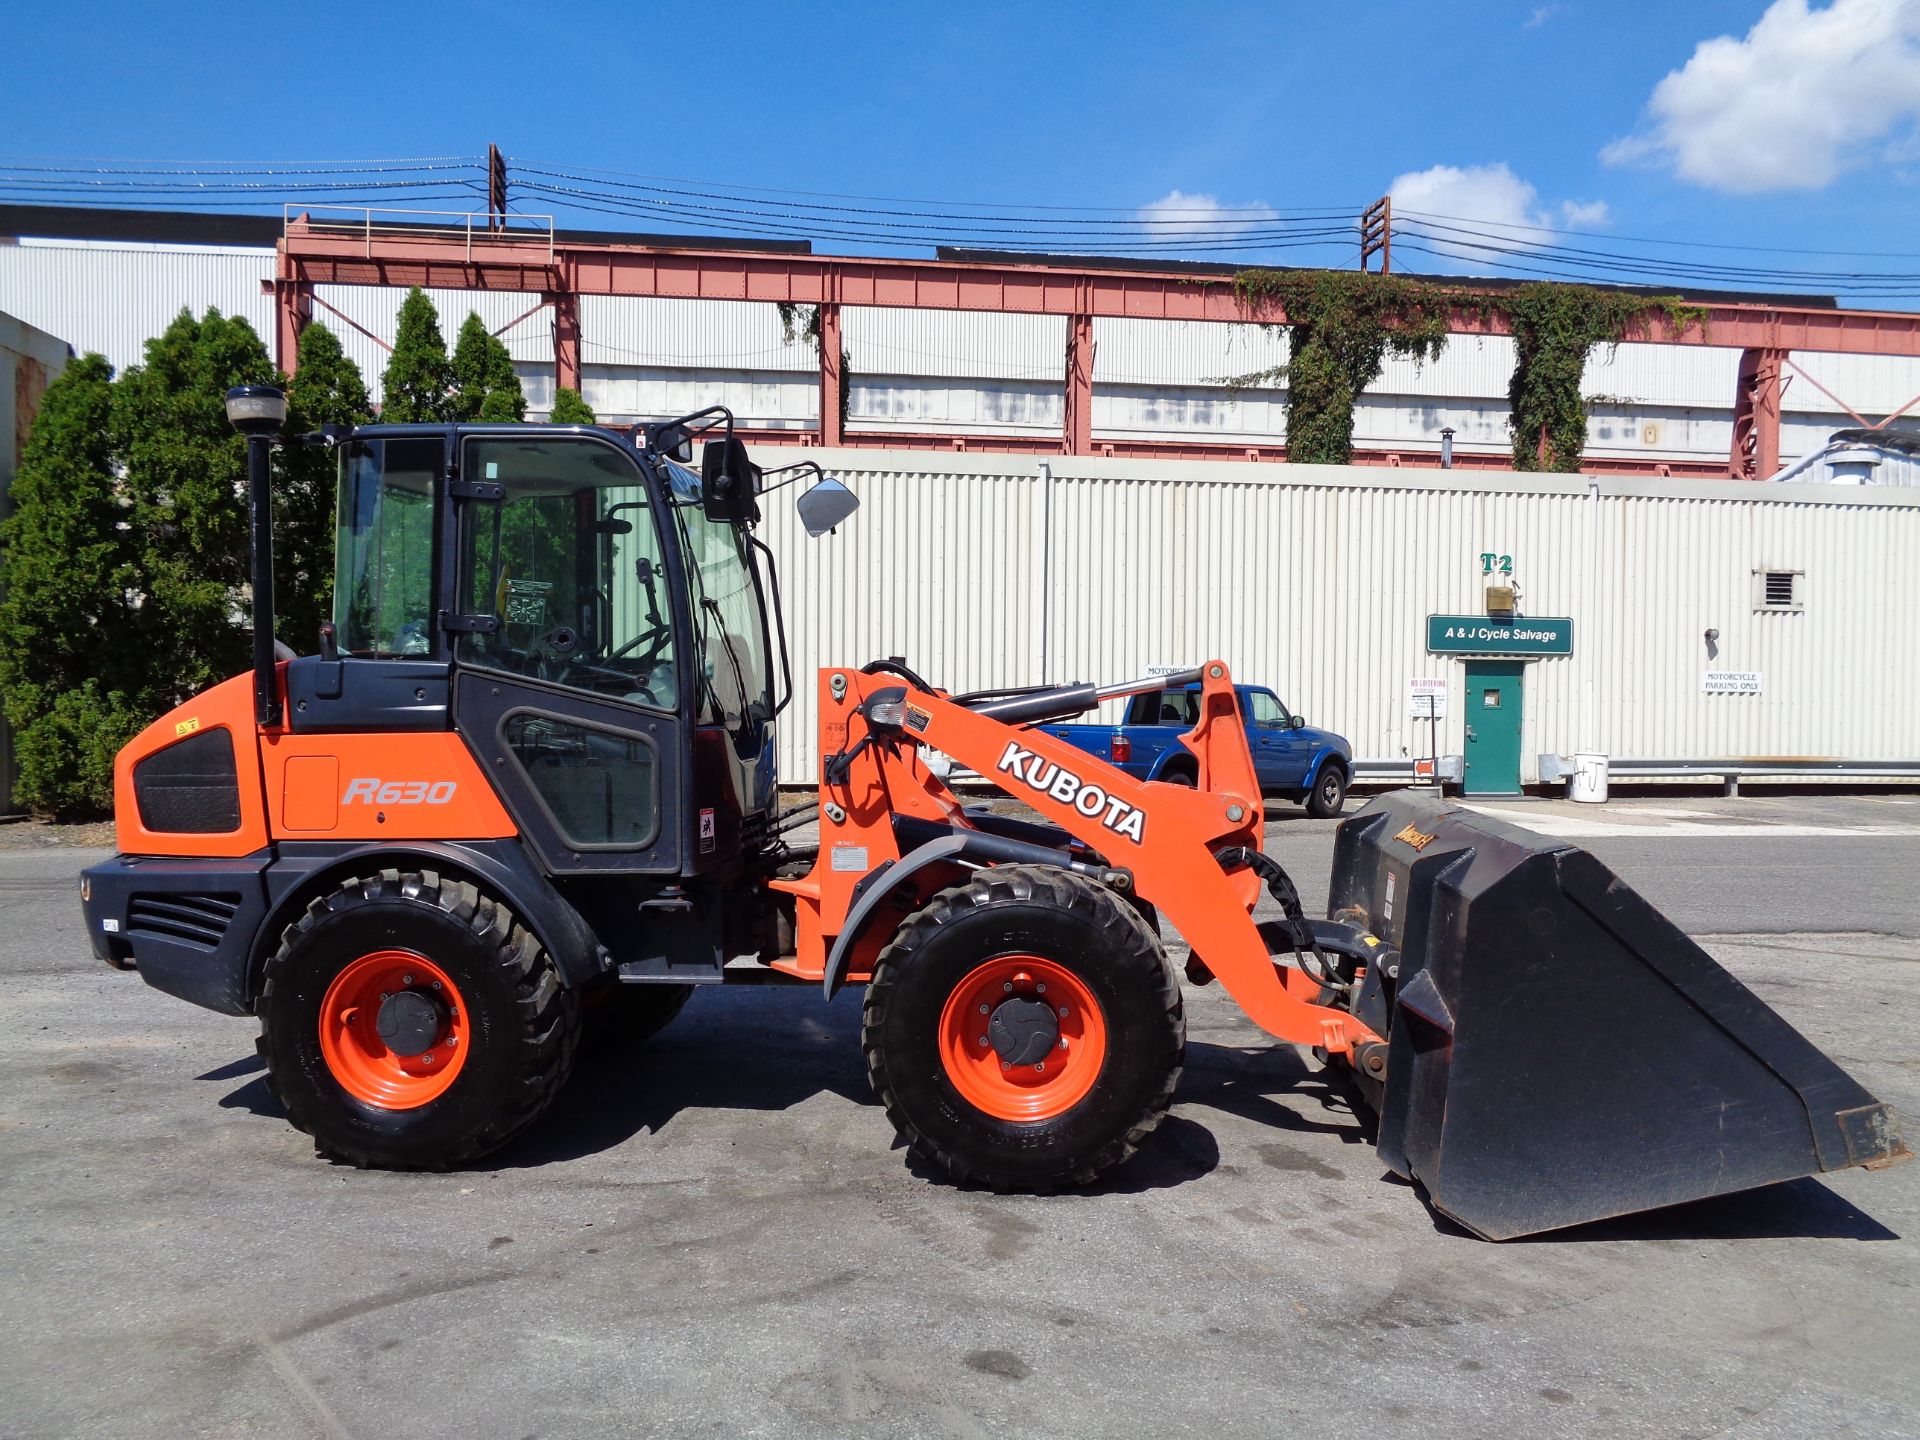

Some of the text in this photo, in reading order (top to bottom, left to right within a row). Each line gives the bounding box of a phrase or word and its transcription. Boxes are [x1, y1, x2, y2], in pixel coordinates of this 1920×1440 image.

[1445, 628, 1557, 643] A & J Cycle Salvage
[1148, 667, 1192, 675] MOTORC
[1707, 673, 1757, 681] MOTORCYCLE
[1410, 679, 1446, 688] NO LOITERING
[1705, 682, 1759, 690] PARKING ONLY
[341, 778, 457, 805] R630
[998, 742, 1145, 843] KUBOTA
